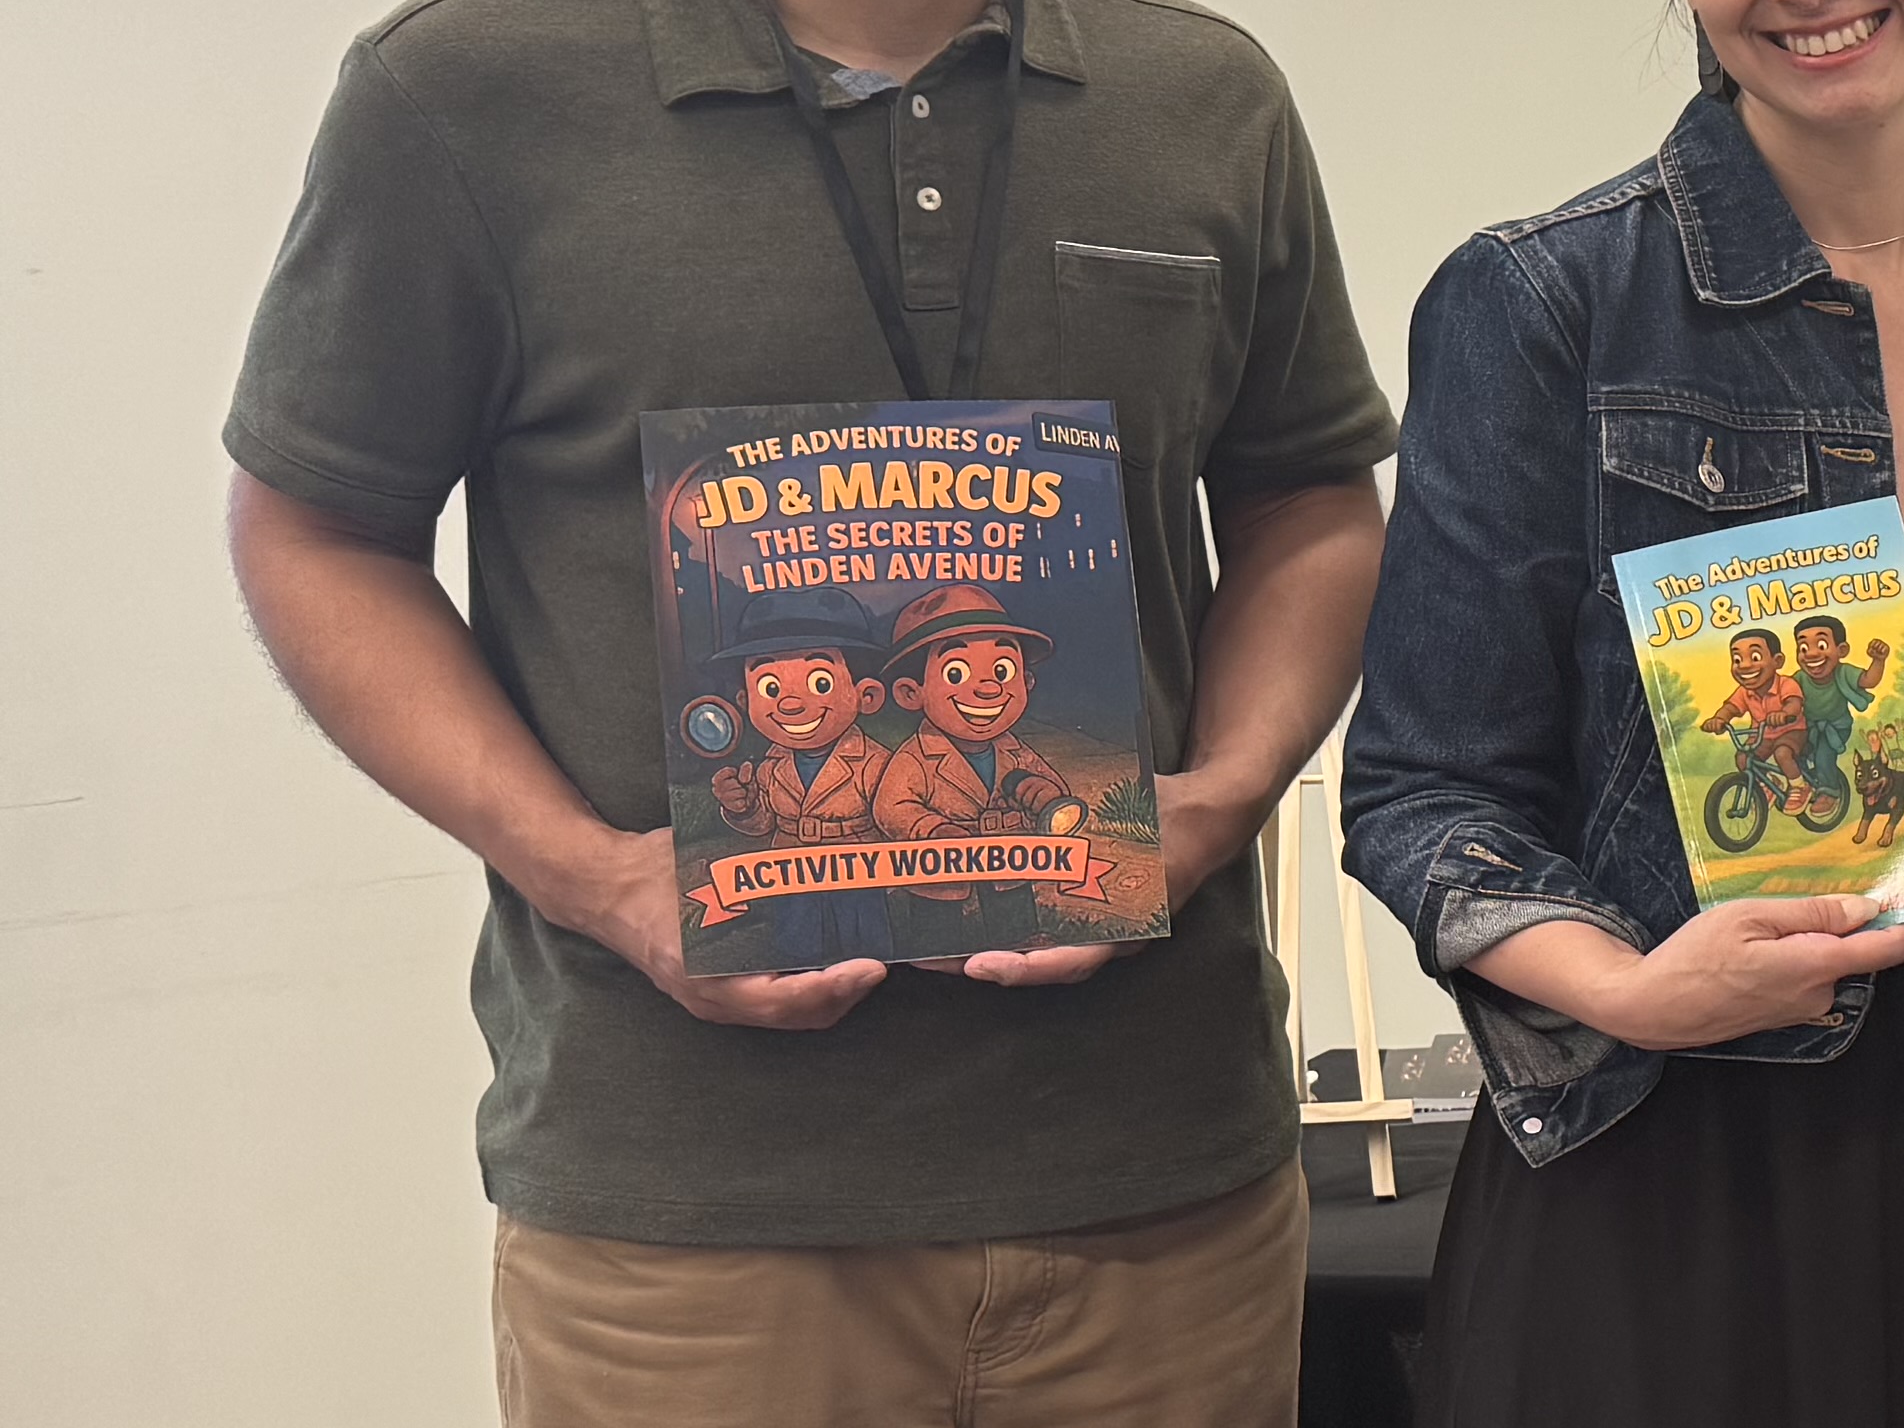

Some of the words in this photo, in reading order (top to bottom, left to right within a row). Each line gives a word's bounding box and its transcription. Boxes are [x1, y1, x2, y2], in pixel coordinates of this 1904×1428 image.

[727, 443, 784, 468] THE
[791, 426, 978, 458] ADVENTURES
[985, 432, 1022, 457] OF
[1040, 422, 1101, 449] LINDEN
[699, 476, 768, 528] JD
[777, 478, 813, 516] &
[818, 461, 1062, 518] MARCUS
[751, 526, 819, 558] THE
[827, 521, 973, 552] SECRETS
[983, 522, 1025, 549] OF
[742, 554, 876, 593] LINDEN
[887, 552, 1023, 582] AVENUE
[1655, 572, 1703, 601] The
[1708, 543, 1851, 585] Adventures
[1853, 534, 1880, 559] of
[1649, 601, 1703, 647] JD
[1711, 595, 1743, 629] &
[1746, 568, 1901, 621] Marcus
[732, 851, 879, 894] ACTIVITY
[890, 846, 1073, 878] WORKBOOK
